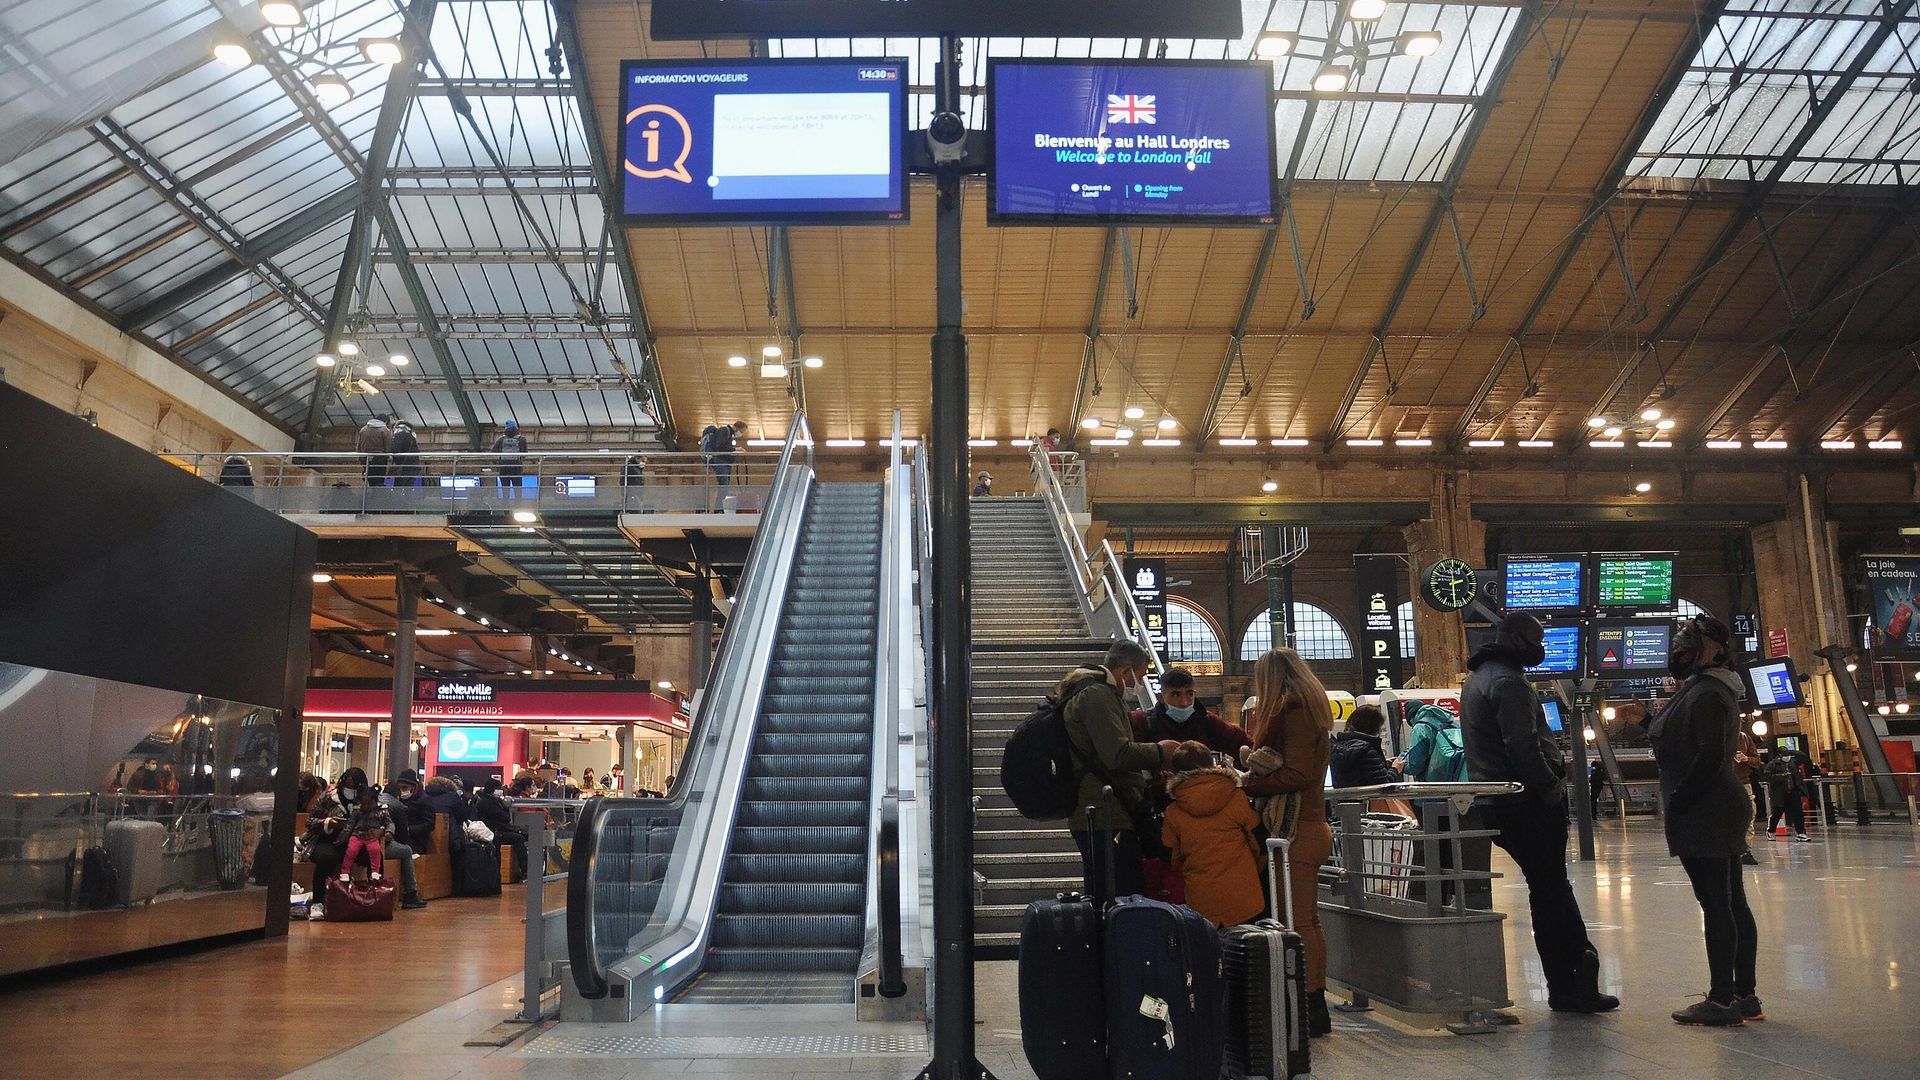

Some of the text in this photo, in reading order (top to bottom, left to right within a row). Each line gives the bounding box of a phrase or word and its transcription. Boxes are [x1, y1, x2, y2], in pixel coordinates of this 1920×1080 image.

[634, 74, 749, 84] INFORMATION VOYAGEURS
[860, 70, 887, 79] 14:30
[1034, 134, 1231, 150] Bienvenue au Hall Londres
[1056, 150, 1212, 164] Welcome to London Hall
[1866, 560, 1895, 570] La joie
[1735, 620, 1750, 632] 14
[1374, 640, 1387, 656] P
[1629, 677, 1676, 686] SEPHORA
[448, 706, 503, 714] GOURMANDS
